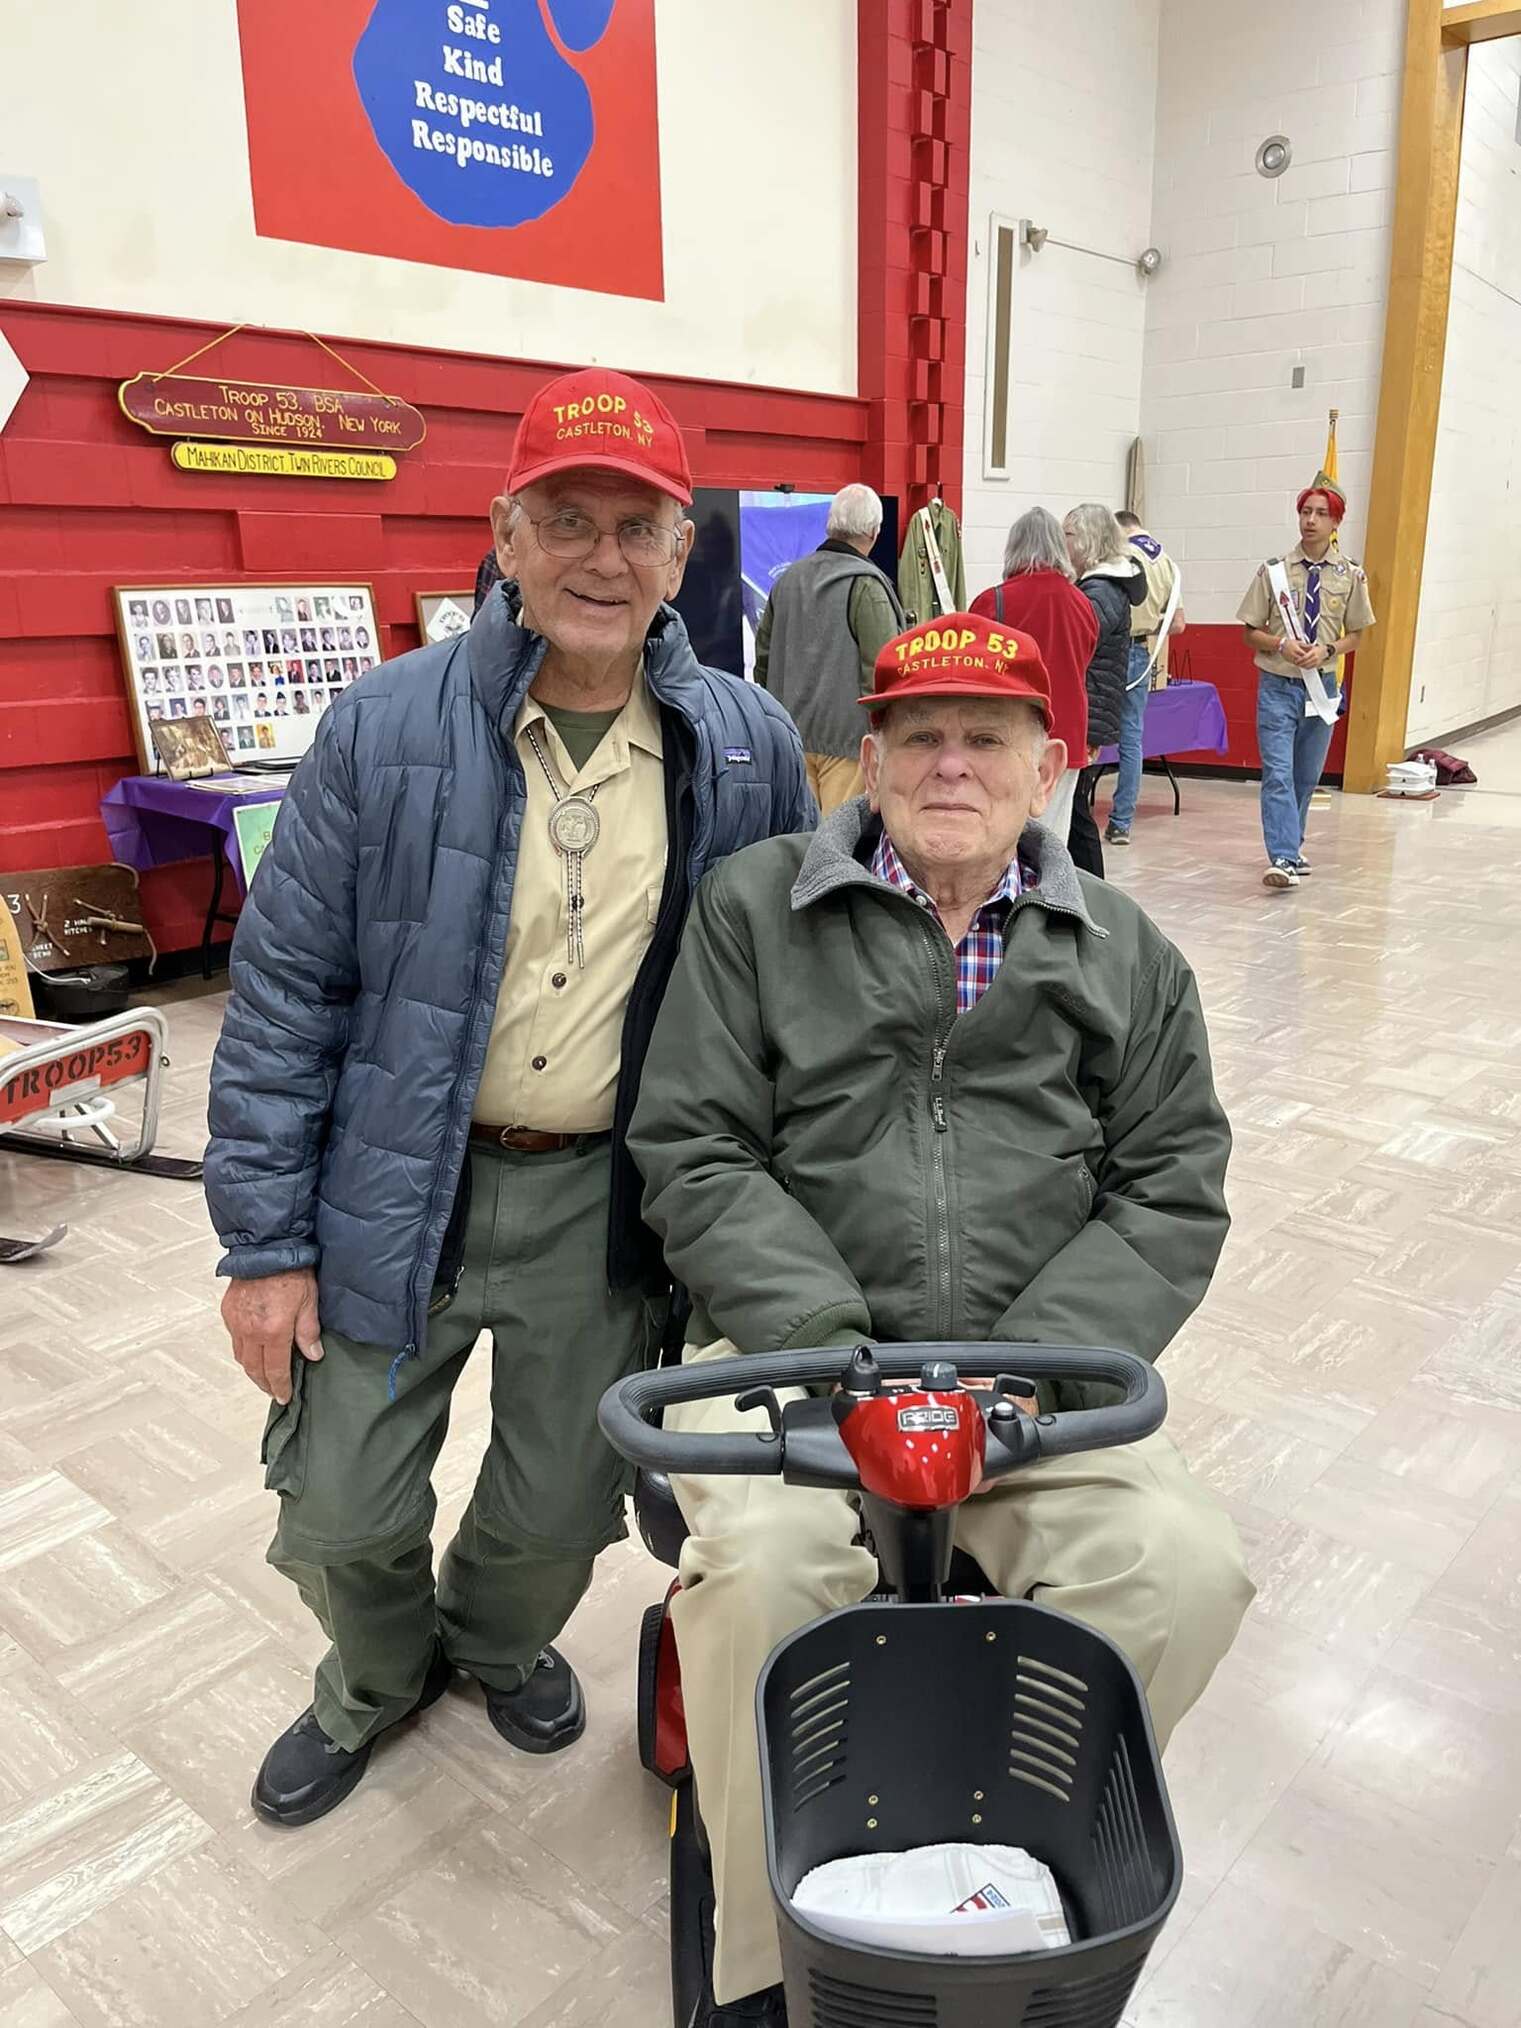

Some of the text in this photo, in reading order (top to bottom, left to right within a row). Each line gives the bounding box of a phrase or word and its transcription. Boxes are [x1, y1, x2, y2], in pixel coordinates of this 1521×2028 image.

[447, 5, 501, 44] Safe
[443, 45, 504, 87] Kind
[414, 80, 543, 137] Respectful
[411, 119, 554, 177] Responsible
[154, 398, 238, 421] CASTLETON
[244, 409, 263, 423] ON
[338, 415, 365, 432] NEW
[218, 385, 269, 406] TROOP
[313, 395, 344, 413] BSA
[553, 394, 654, 434] TROOP 53
[251, 423, 323, 439] SINCE 1924
[637, 433, 653, 448] NY
[288, 452, 310, 473] TWIN
[311, 454, 347, 475] RIVERS
[348, 457, 386, 477] COUNCIL
[896, 629, 1018, 661] TROOP 53
